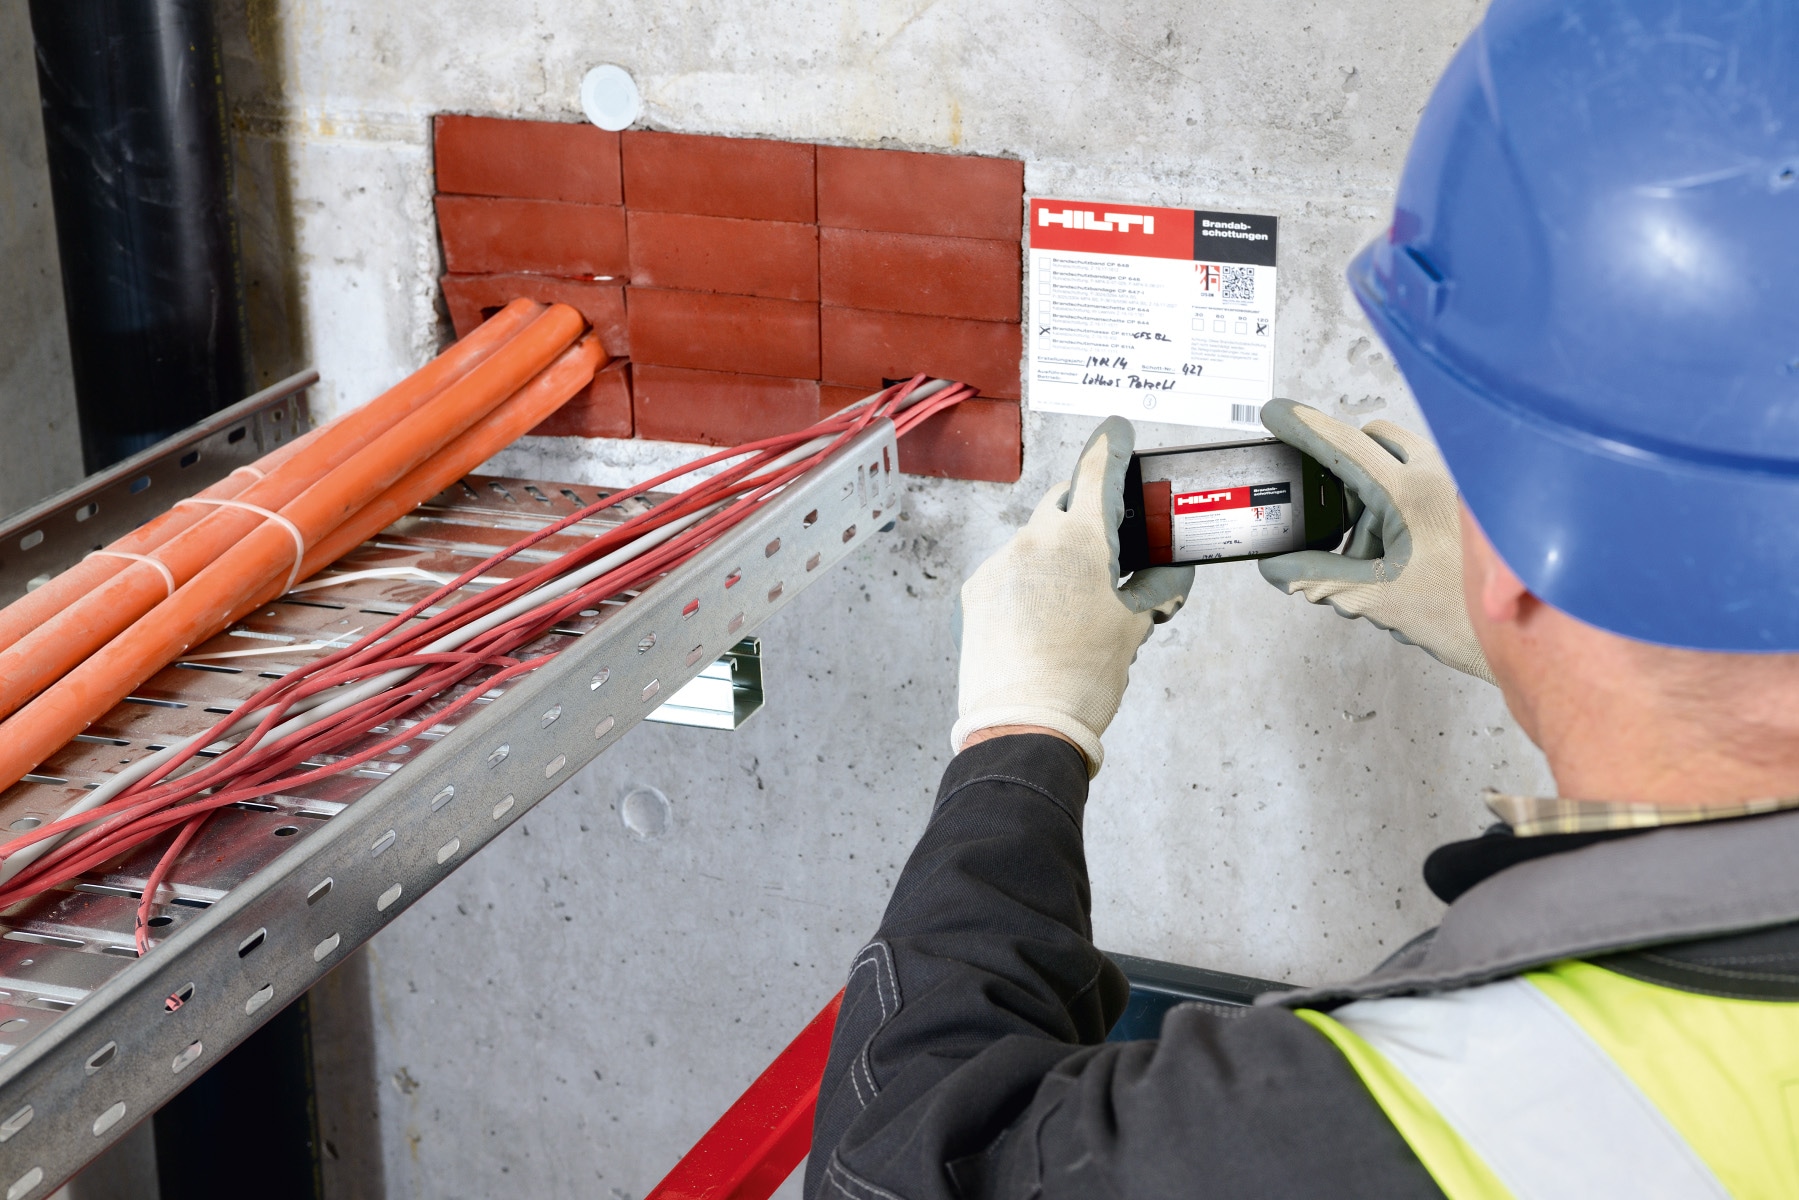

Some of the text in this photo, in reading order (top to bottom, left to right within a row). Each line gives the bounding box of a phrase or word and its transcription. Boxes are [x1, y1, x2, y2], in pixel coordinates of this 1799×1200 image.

[1038, 208, 1154, 234] HILTI
[1202, 219, 1251, 231] Brandab-
[1202, 229, 1268, 241] schottungen
[1177, 492, 1232, 506] HILTI
